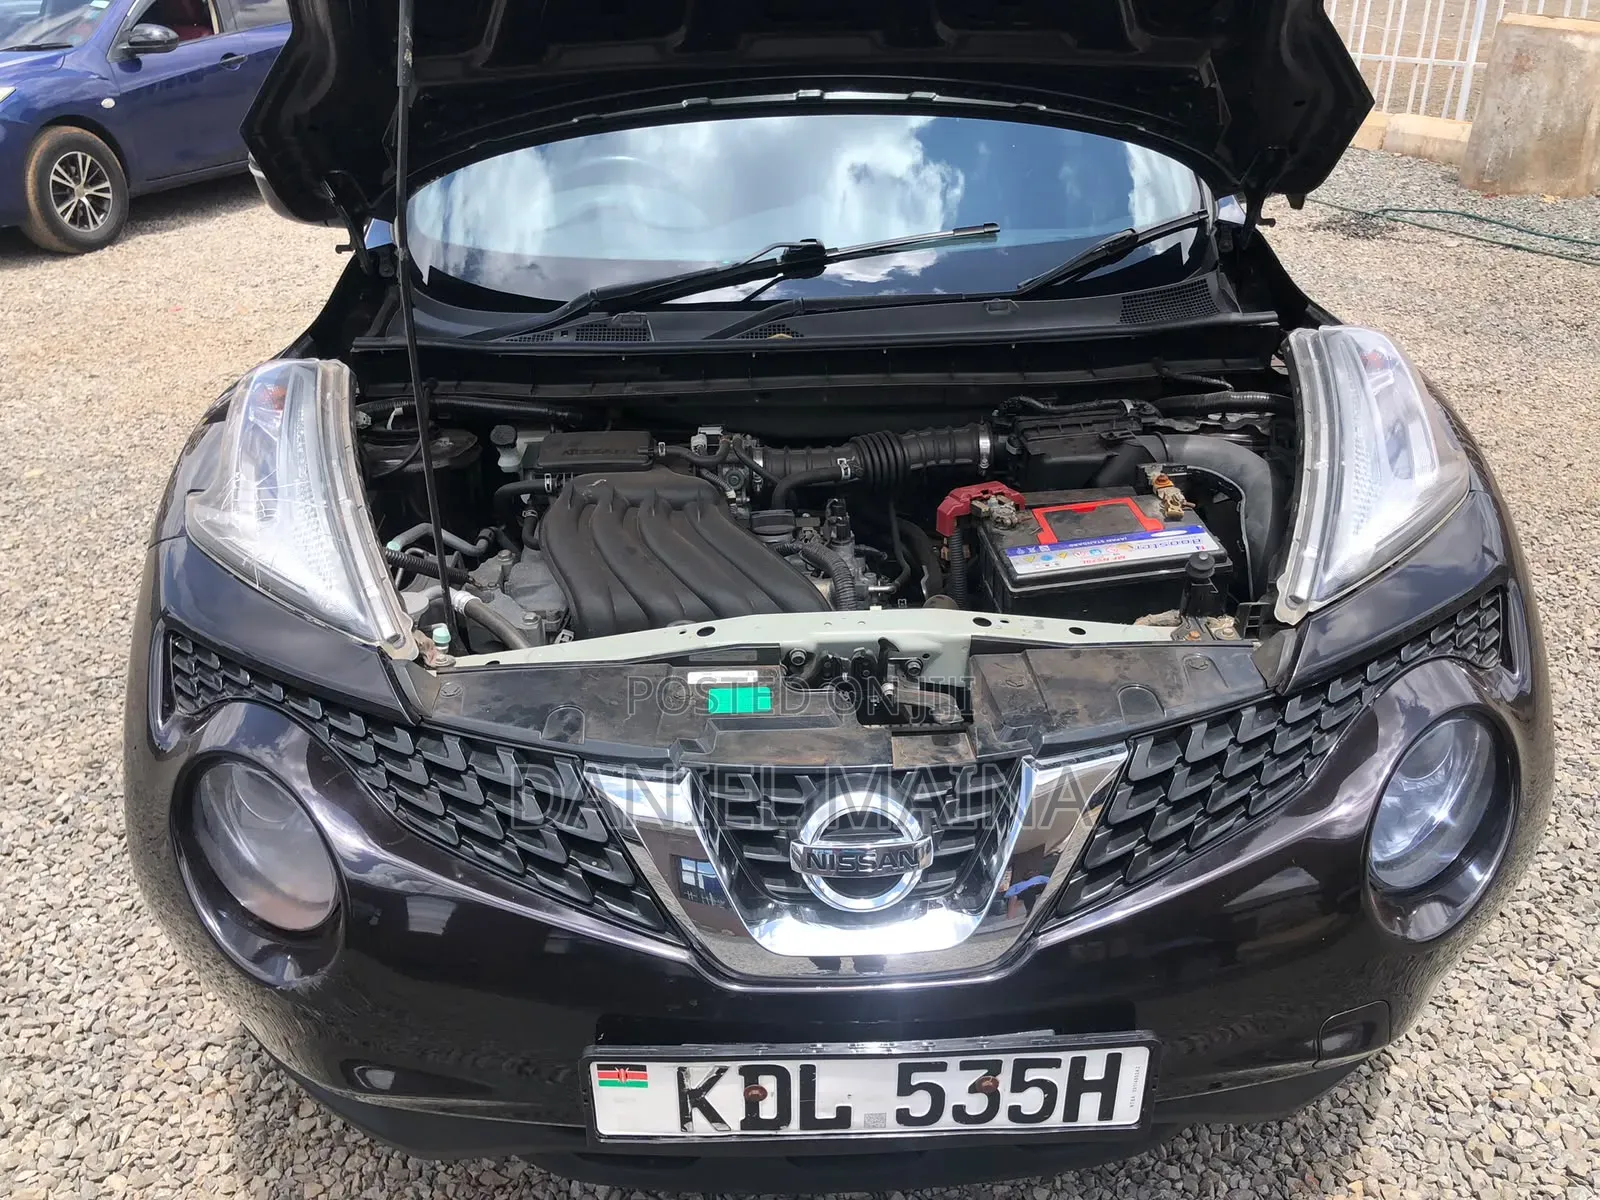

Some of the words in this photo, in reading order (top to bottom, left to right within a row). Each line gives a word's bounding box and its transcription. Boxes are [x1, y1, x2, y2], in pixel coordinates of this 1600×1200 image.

[806, 845, 920, 873] NISSAN
[676, 1063, 852, 1132] KDL
[895, 1052, 1124, 1127] 535H
